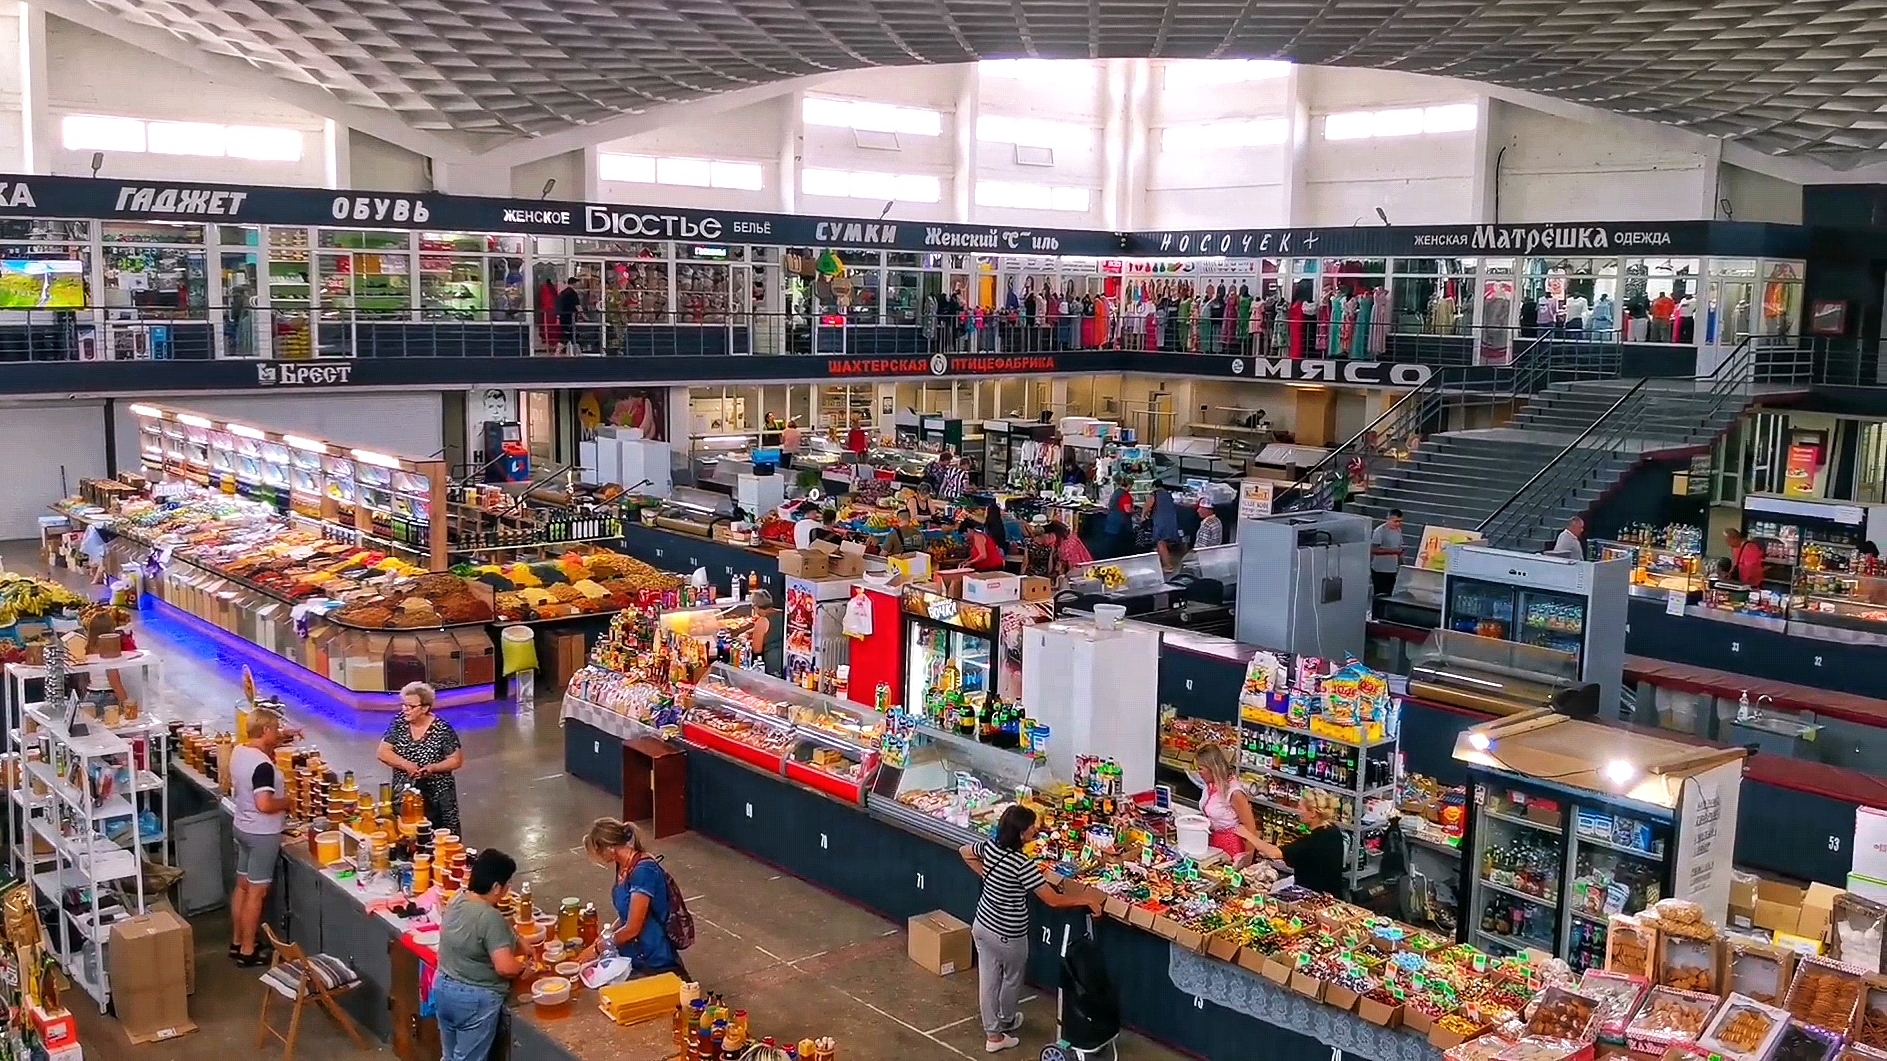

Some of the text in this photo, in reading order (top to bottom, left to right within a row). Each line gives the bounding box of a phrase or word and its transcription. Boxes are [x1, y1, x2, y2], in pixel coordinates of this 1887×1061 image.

[114, 186, 248, 215] ГАДЖЕТ
[332, 197, 430, 222] ОБУВЬ
[503, 206, 771, 239] ЖЕНСКОЕ Бюстье БЕЛЬЁ
[815, 222, 897, 243] СУМКИ
[924, 226, 1059, 250] Женский Силь
[1160, 232, 1292, 253] НОСОЧЕК
[1414, 223, 1671, 255] ЖЕНСКАЯ Матрёшка ОДЕЖДА
[828, 356, 1054, 374] ШАХТЕРСКАЯ ПТИЦЕФАБРИКА
[1255, 357, 1432, 385] МЯСО
[1828, 835, 1840, 852] 53
[916, 872, 924, 890] 71
[1042, 925, 1051, 945] 72
